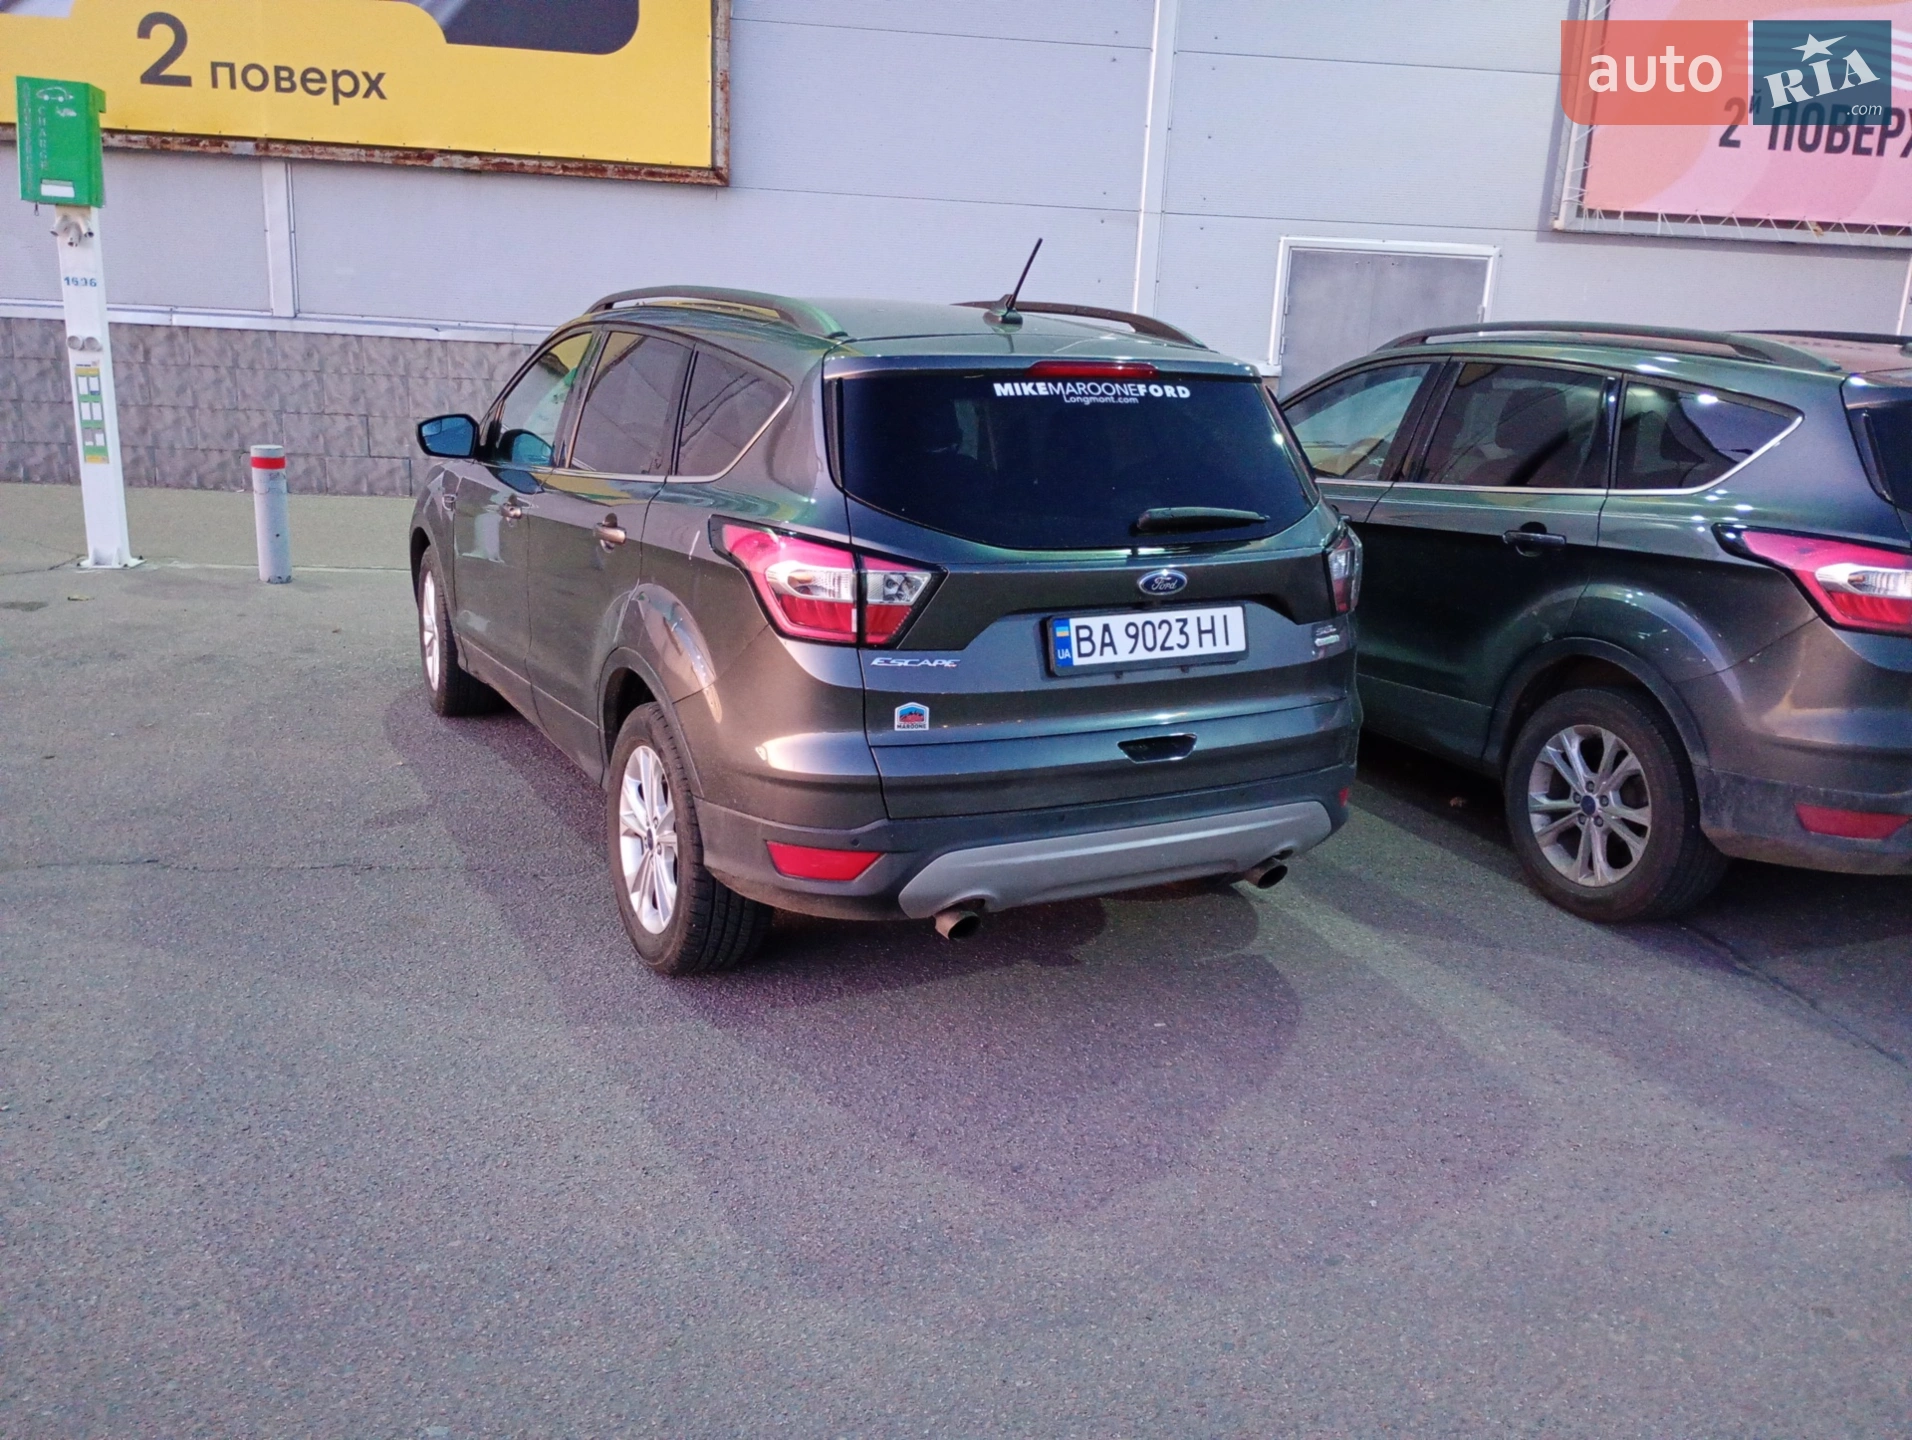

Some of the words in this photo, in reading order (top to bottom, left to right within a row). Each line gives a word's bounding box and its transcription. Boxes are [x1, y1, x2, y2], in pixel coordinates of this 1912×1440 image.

[137, 11, 192, 87] 2
[210, 61, 388, 106] поверх
[1064, 395, 1139, 405] Longmont.com
[1151, 576, 1177, 590] Ford
[1075, 623, 1117, 658] BA
[1125, 618, 1190, 654] 9023
[1057, 648, 1071, 659] UA
[871, 657, 960, 668] ESCAPE
